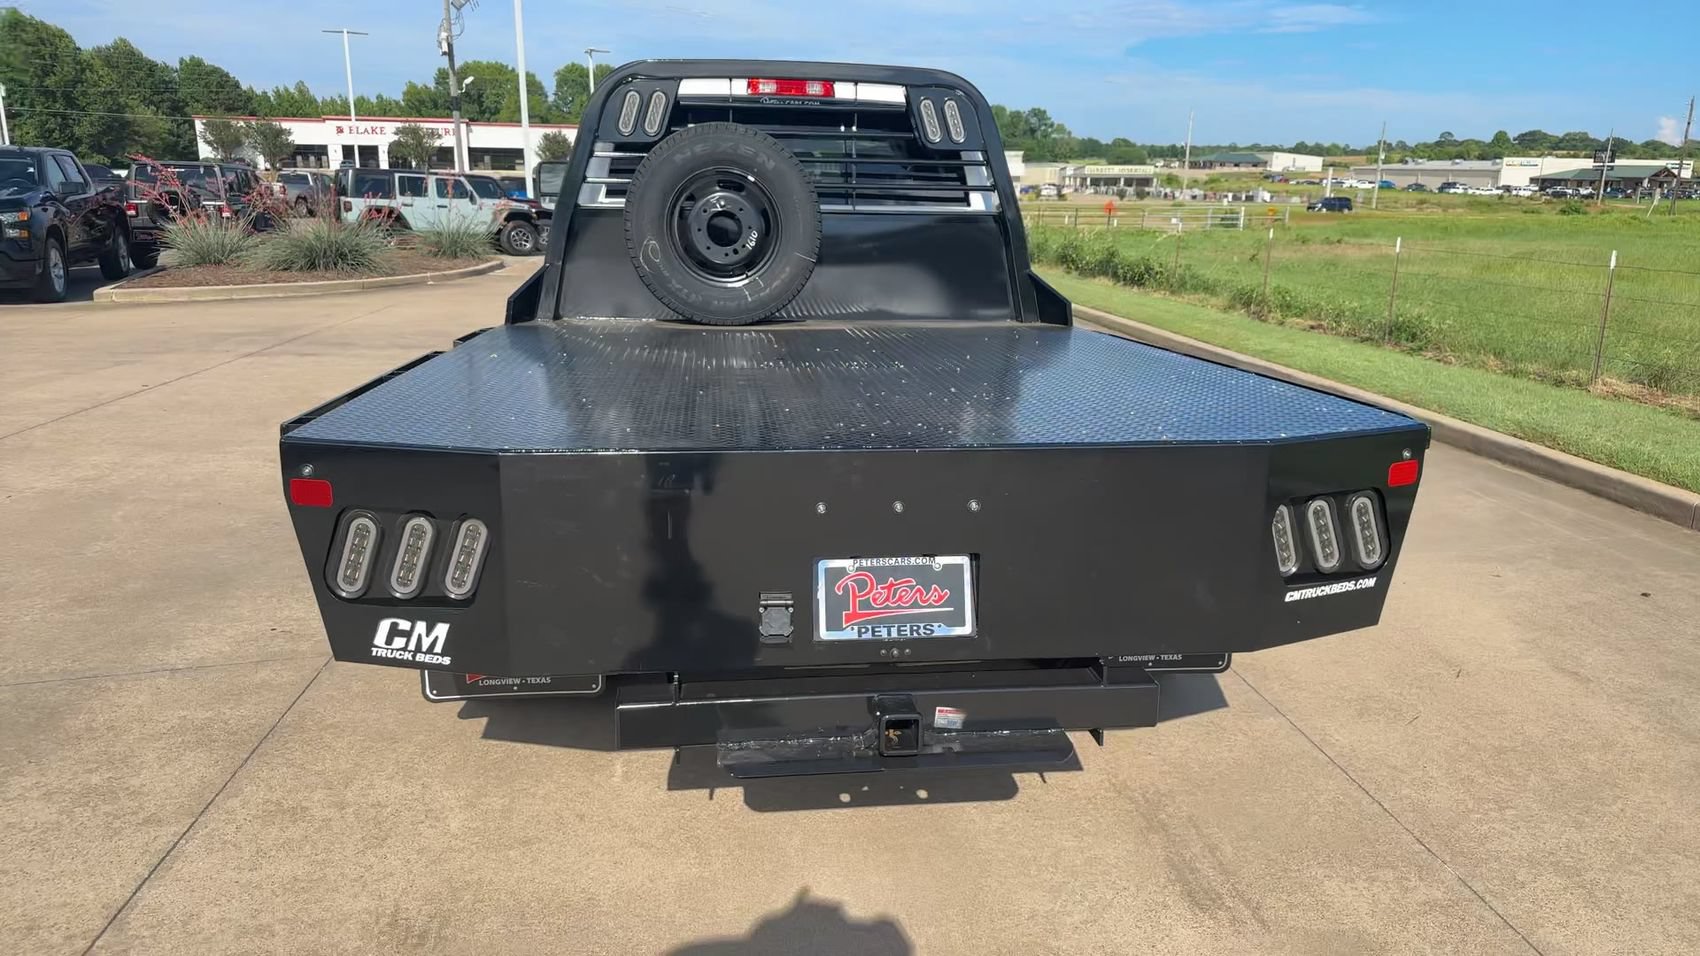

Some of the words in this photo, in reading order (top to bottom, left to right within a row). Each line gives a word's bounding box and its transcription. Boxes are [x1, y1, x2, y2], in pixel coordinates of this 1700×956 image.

[852, 556, 937, 567] PETERSCARS.COM
[1284, 577, 1377, 602] CMTRUCKBEDS.COM
[835, 572, 950, 626] Peters
[372, 617, 451, 654] CM
[856, 623, 936, 638] PETERS
[371, 647, 414, 661] TRUCK
[415, 652, 452, 665] BEDS
[1119, 654, 1156, 662] LONGVIEW
[479, 677, 521, 686] LONGVIEW
[526, 676, 552, 684] TEXAS
